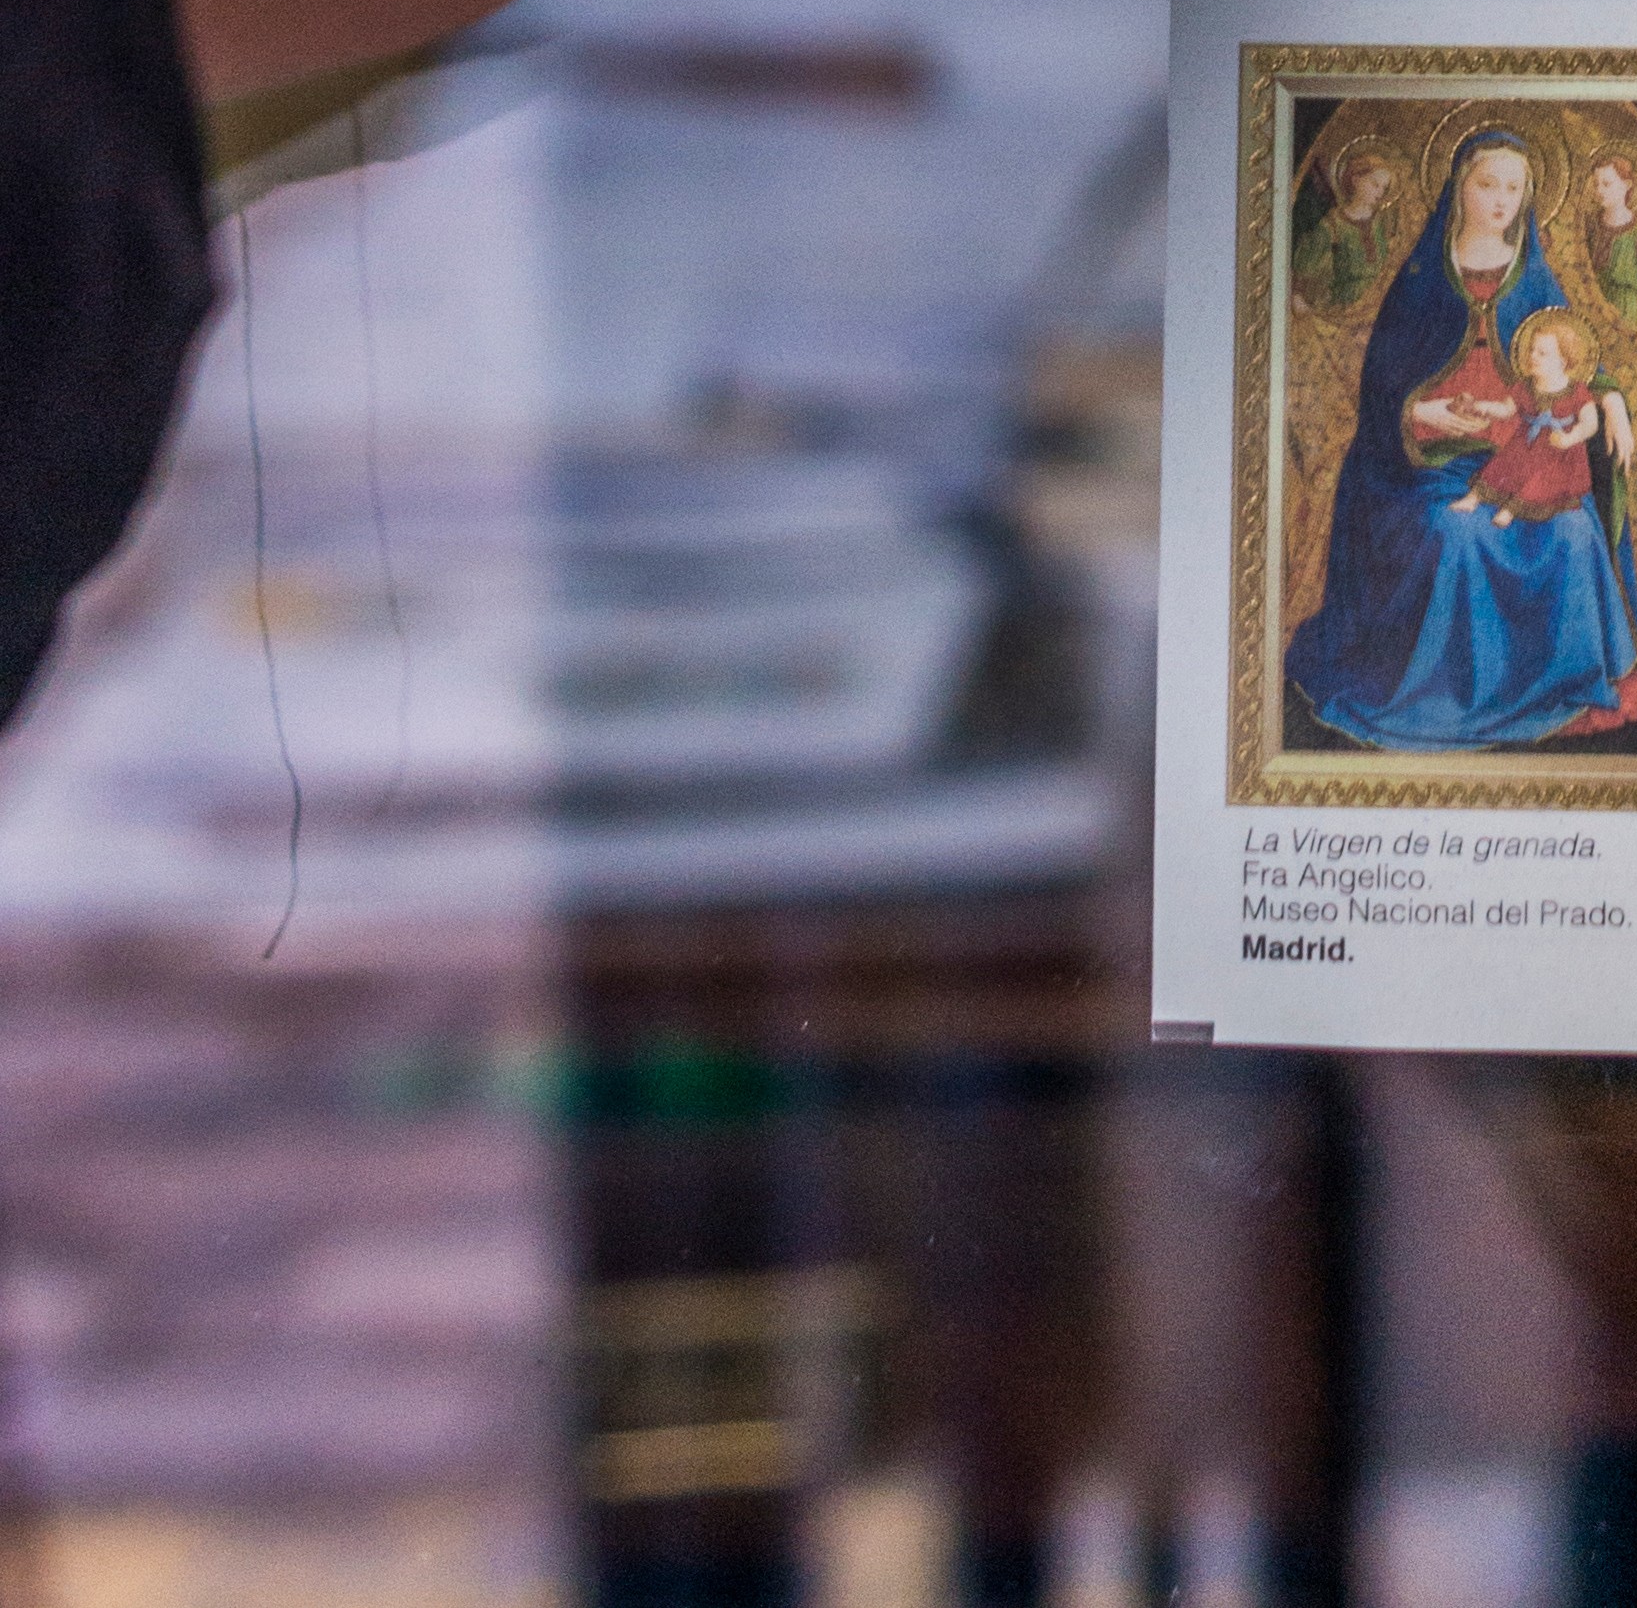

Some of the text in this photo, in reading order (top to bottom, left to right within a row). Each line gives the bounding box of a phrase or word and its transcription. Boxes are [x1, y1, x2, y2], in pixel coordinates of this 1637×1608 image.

[1242, 897, 1633, 929] Museo Nacional del Prado.
[1241, 936, 1355, 963] Madrid.
